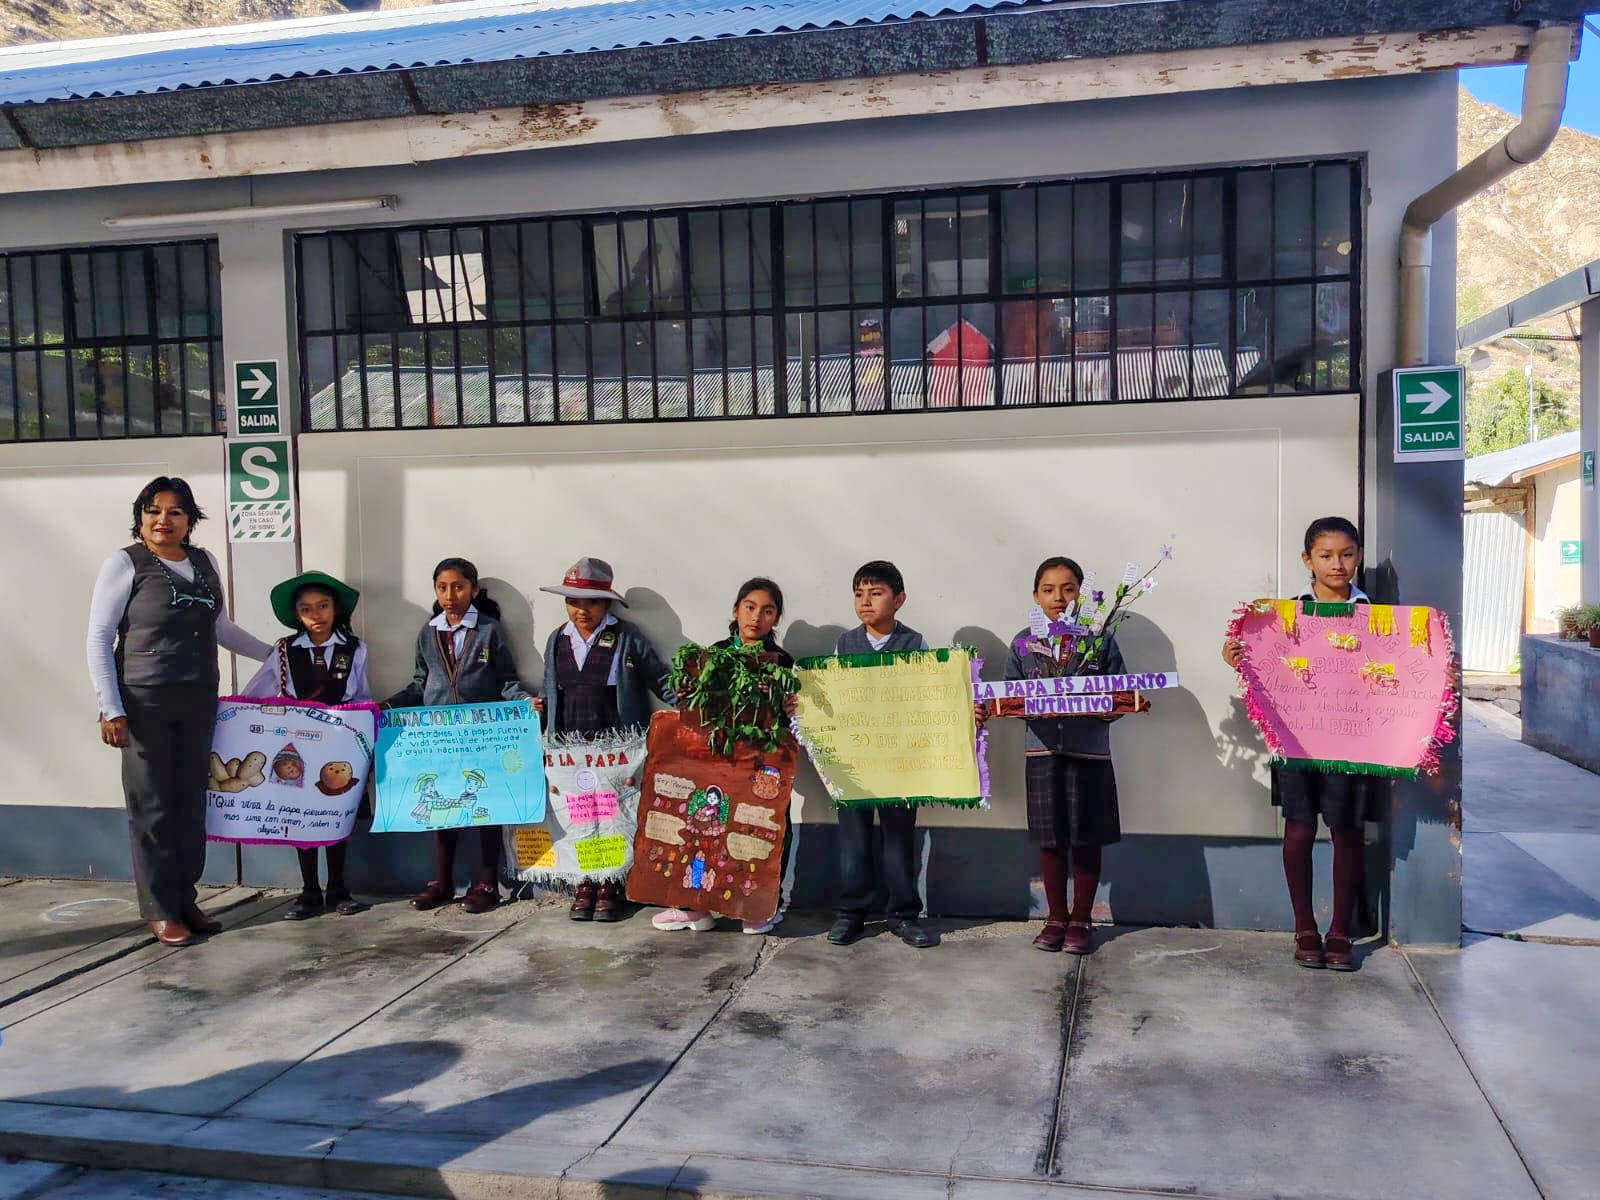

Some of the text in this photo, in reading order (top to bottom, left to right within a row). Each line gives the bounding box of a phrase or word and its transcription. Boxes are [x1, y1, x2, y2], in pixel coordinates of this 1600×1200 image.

[240, 414, 277, 428] SALIDA
[1404, 431, 1455, 444] SALIDA
[240, 446, 280, 500] S
[1316, 657, 1358, 674] PAPA
[973, 673, 1167, 699] LA PAPA ES ALIMENTO
[1025, 697, 1112, 714] NUTRITIVO
[308, 709, 342, 726] PAPA
[275, 727, 286, 735] de
[297, 731, 320, 740] mayo
[497, 727, 529, 735] fuente
[405, 748, 433, 757] orgullo
[437, 746, 473, 755] nacional
[476, 745, 487, 753] del
[409, 739, 430, 748] vida
[559, 753, 575, 766] LA
[585, 752, 629, 767] PAPA
[240, 800, 262, 810] viva
[265, 800, 275, 811] la
[278, 804, 301, 815] papa
[223, 813, 240, 822] nos
[245, 815, 262, 823] une
[265, 815, 279, 824] con
[281, 817, 305, 828] amor,
[308, 818, 330, 828] sabor
